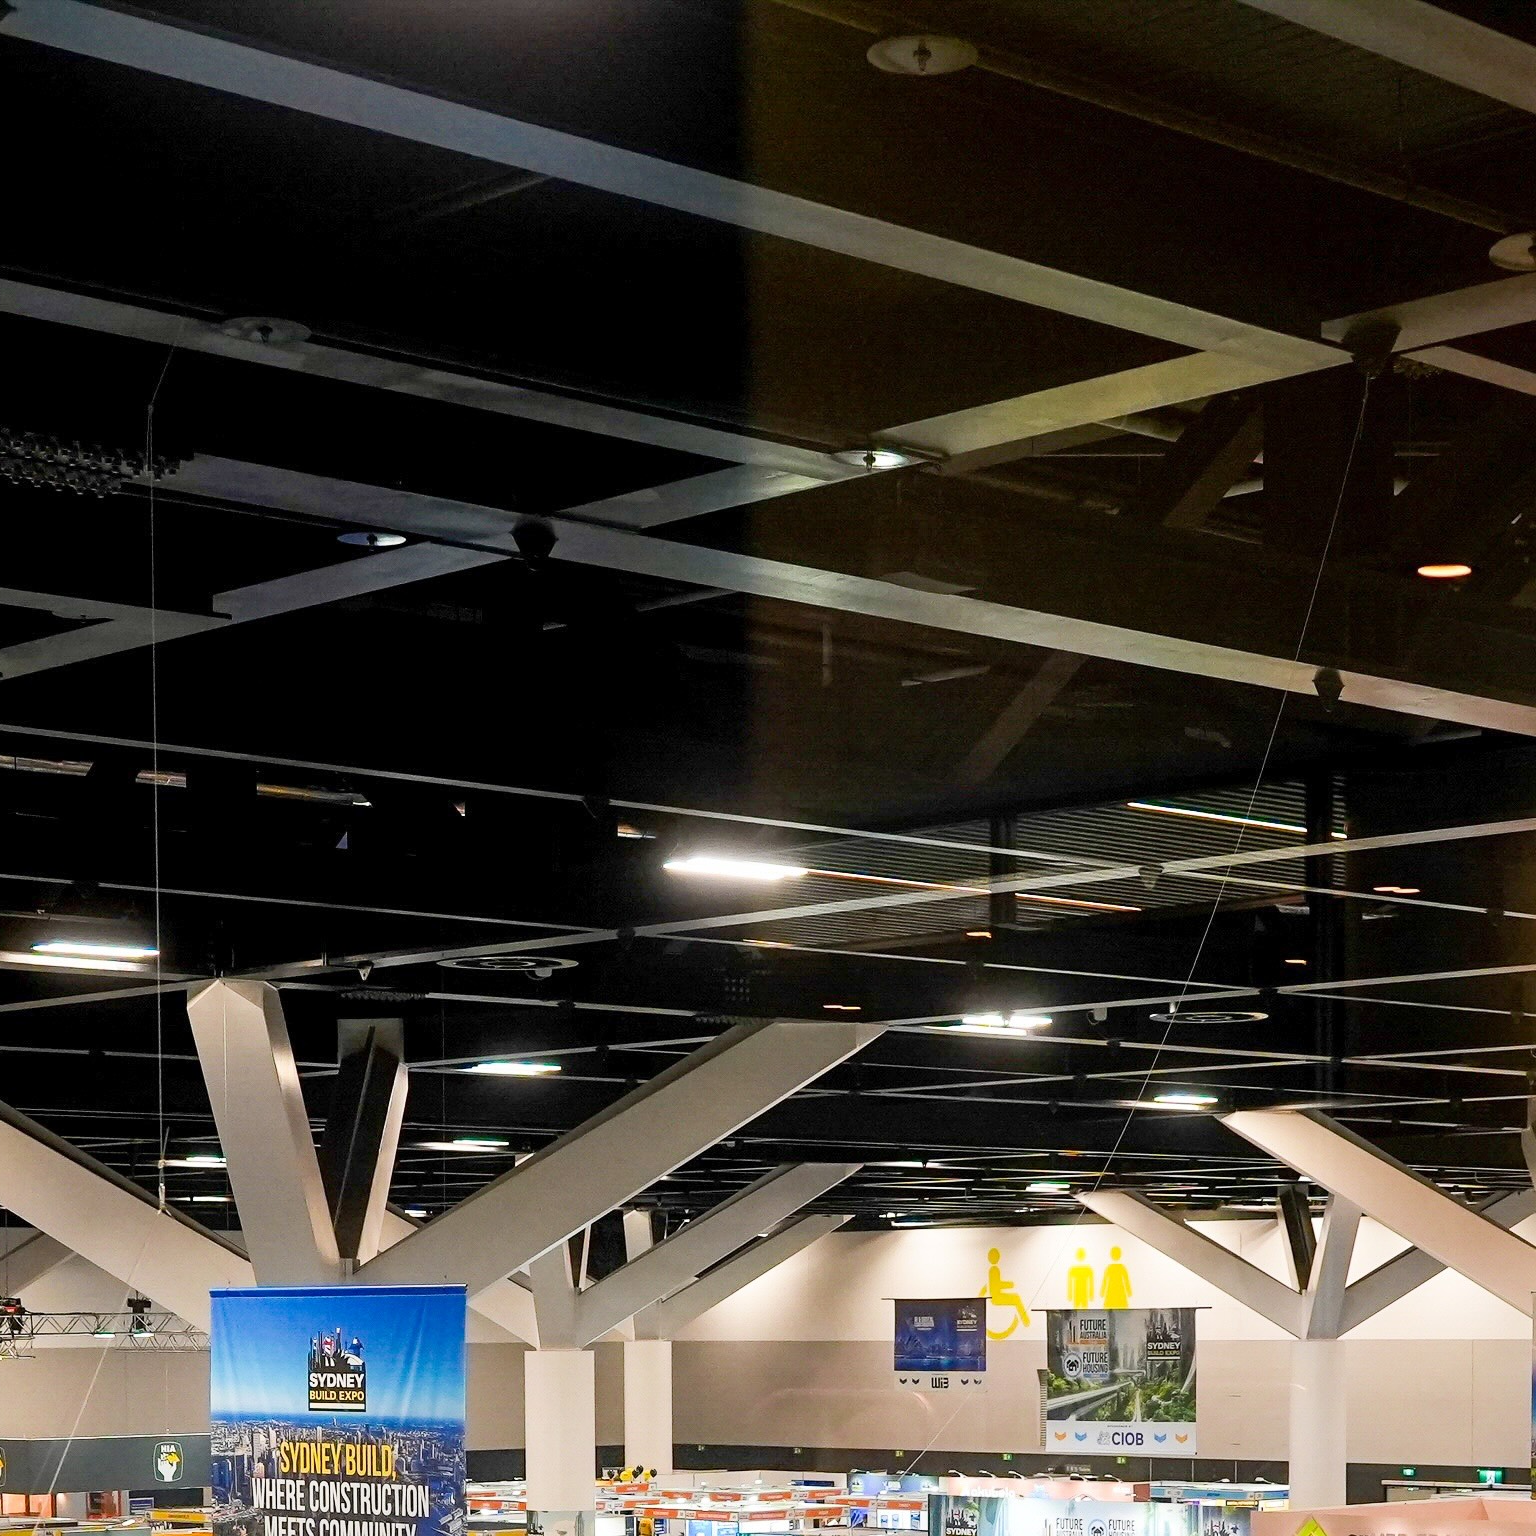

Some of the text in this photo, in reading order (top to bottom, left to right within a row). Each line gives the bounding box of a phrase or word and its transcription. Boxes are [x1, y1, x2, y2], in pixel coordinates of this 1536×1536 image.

[1080, 1319, 1106, 1331] FUTURE
[1147, 1342, 1181, 1351] SYDNEY
[1083, 1352, 1108, 1364] FUTURE
[1083, 1363, 1108, 1374] HOUSING
[309, 1373, 364, 1388] SYDNEY
[309, 1390, 364, 1401] BUILD EXPO
[1111, 1432, 1144, 1446] CIOB
[160, 1444, 176, 1454] HIA
[280, 1441, 397, 1481] SYDNEY BUILD,
[252, 1478, 430, 1517] WHERE CONSTRUCTION
[1056, 1518, 1083, 1531] FUTURE
[1109, 1519, 1135, 1532] FUTURE
[946, 1528, 977, 1536] SYDNEY
